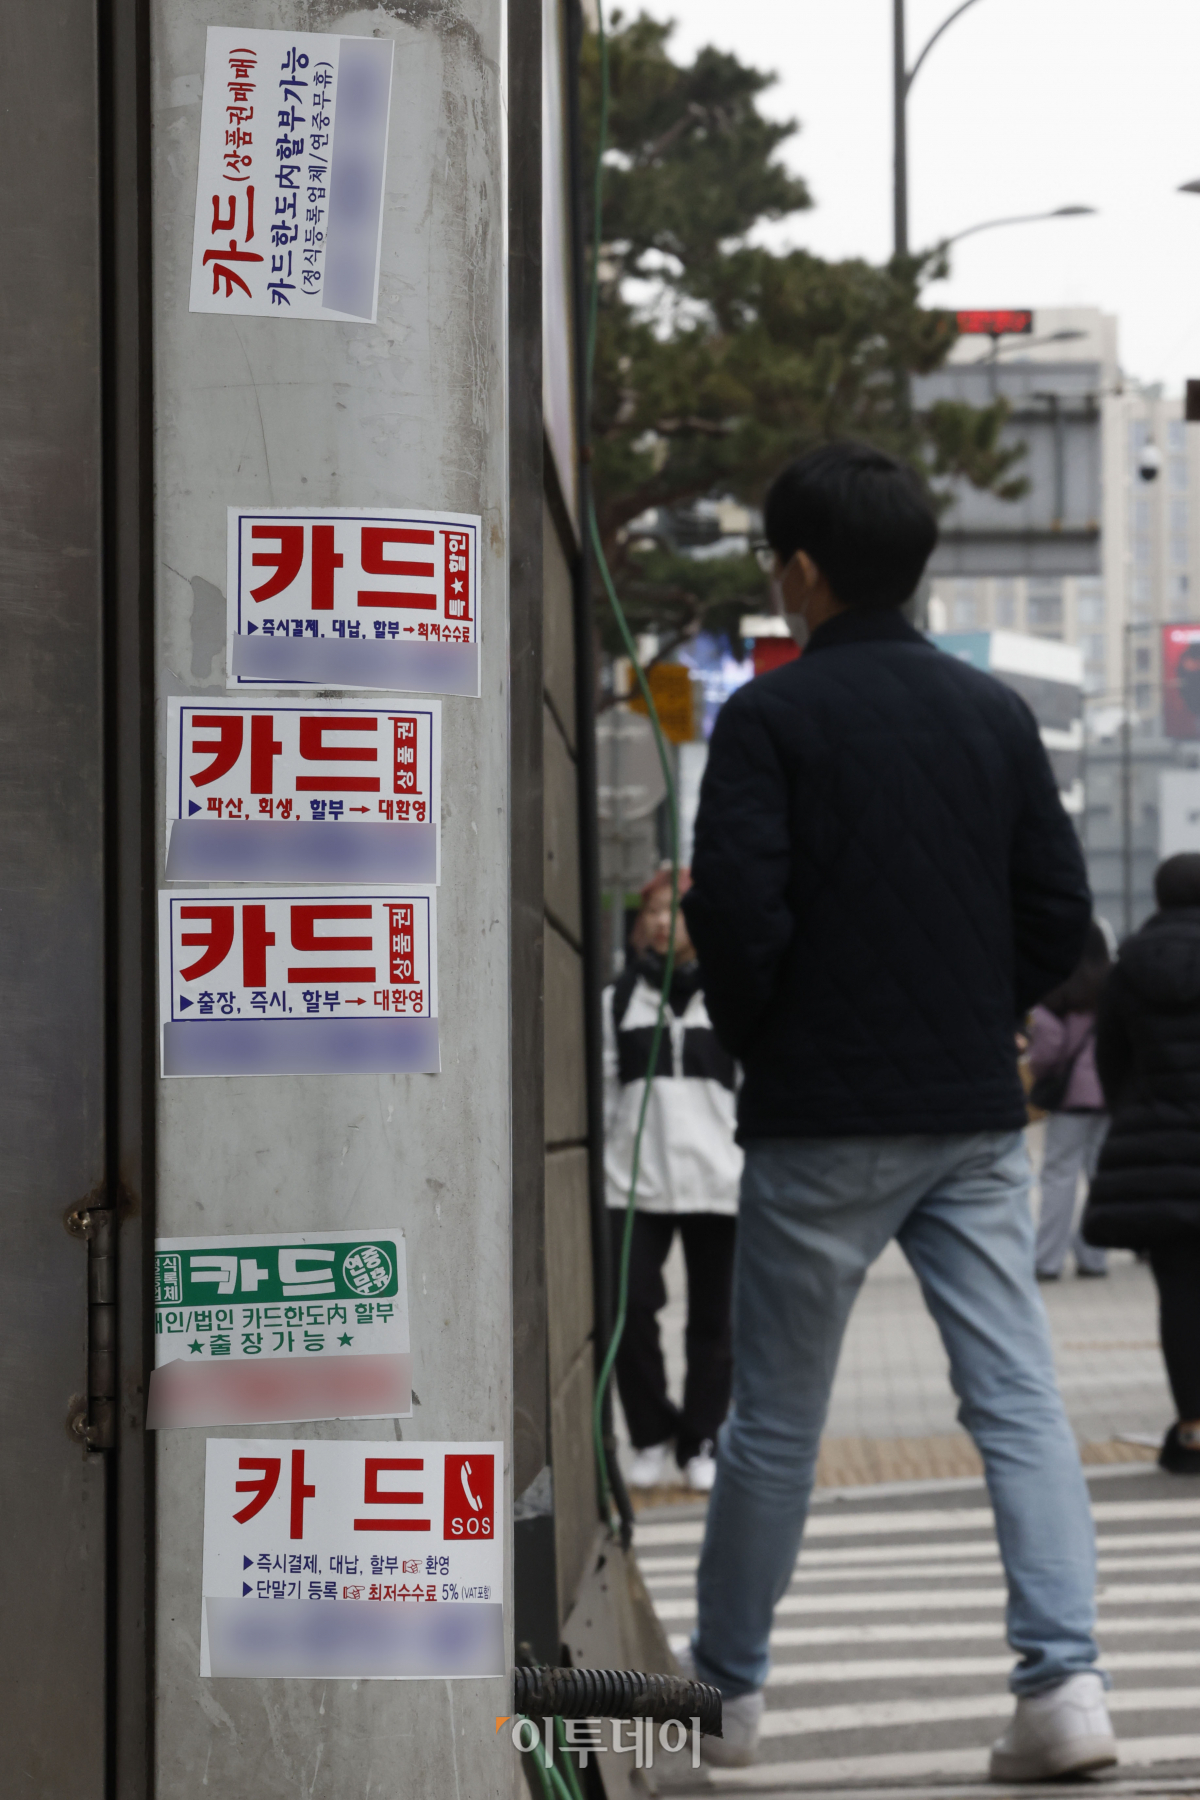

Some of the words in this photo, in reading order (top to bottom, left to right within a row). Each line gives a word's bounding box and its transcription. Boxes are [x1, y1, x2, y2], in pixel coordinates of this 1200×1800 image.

[222, 48, 258, 182] (상품권매매)
[202, 185, 264, 298] 카드
[249, 525, 437, 610] 카드
[262, 618, 325, 638] 즉시결제,
[332, 619, 366, 639] 대납,
[373, 620, 400, 639] 할부
[417, 622, 471, 643] 최저수수료
[189, 714, 381, 794] 카드
[396, 721, 414, 789] 상품권
[206, 797, 250, 820] 파산,
[258, 797, 300, 820] 회생,
[309, 798, 344, 821] 할부
[378, 799, 426, 822] 대환영
[179, 904, 376, 988] 카드
[392, 908, 412, 980] 상품권
[197, 990, 241, 1015] 출장,
[250, 990, 293, 1014] 즉시,
[301, 989, 341, 1013] 할부
[373, 988, 423, 1014] 대환영
[190, 1248, 336, 1296] 카드
[354, 1302, 394, 1325] 할부
[232, 1449, 431, 1540] 카드
[451, 1517, 491, 1535] SOS
[256, 1553, 322, 1575] 즉시결제,
[329, 1554, 363, 1576] 대납,
[370, 1555, 399, 1575] 할부
[425, 1556, 450, 1576] 환영
[256, 1580, 301, 1600] 단말기
[307, 1580, 338, 1600] 등록
[368, 1583, 438, 1602] 최저수수료
[441, 1583, 459, 1601] 5%
